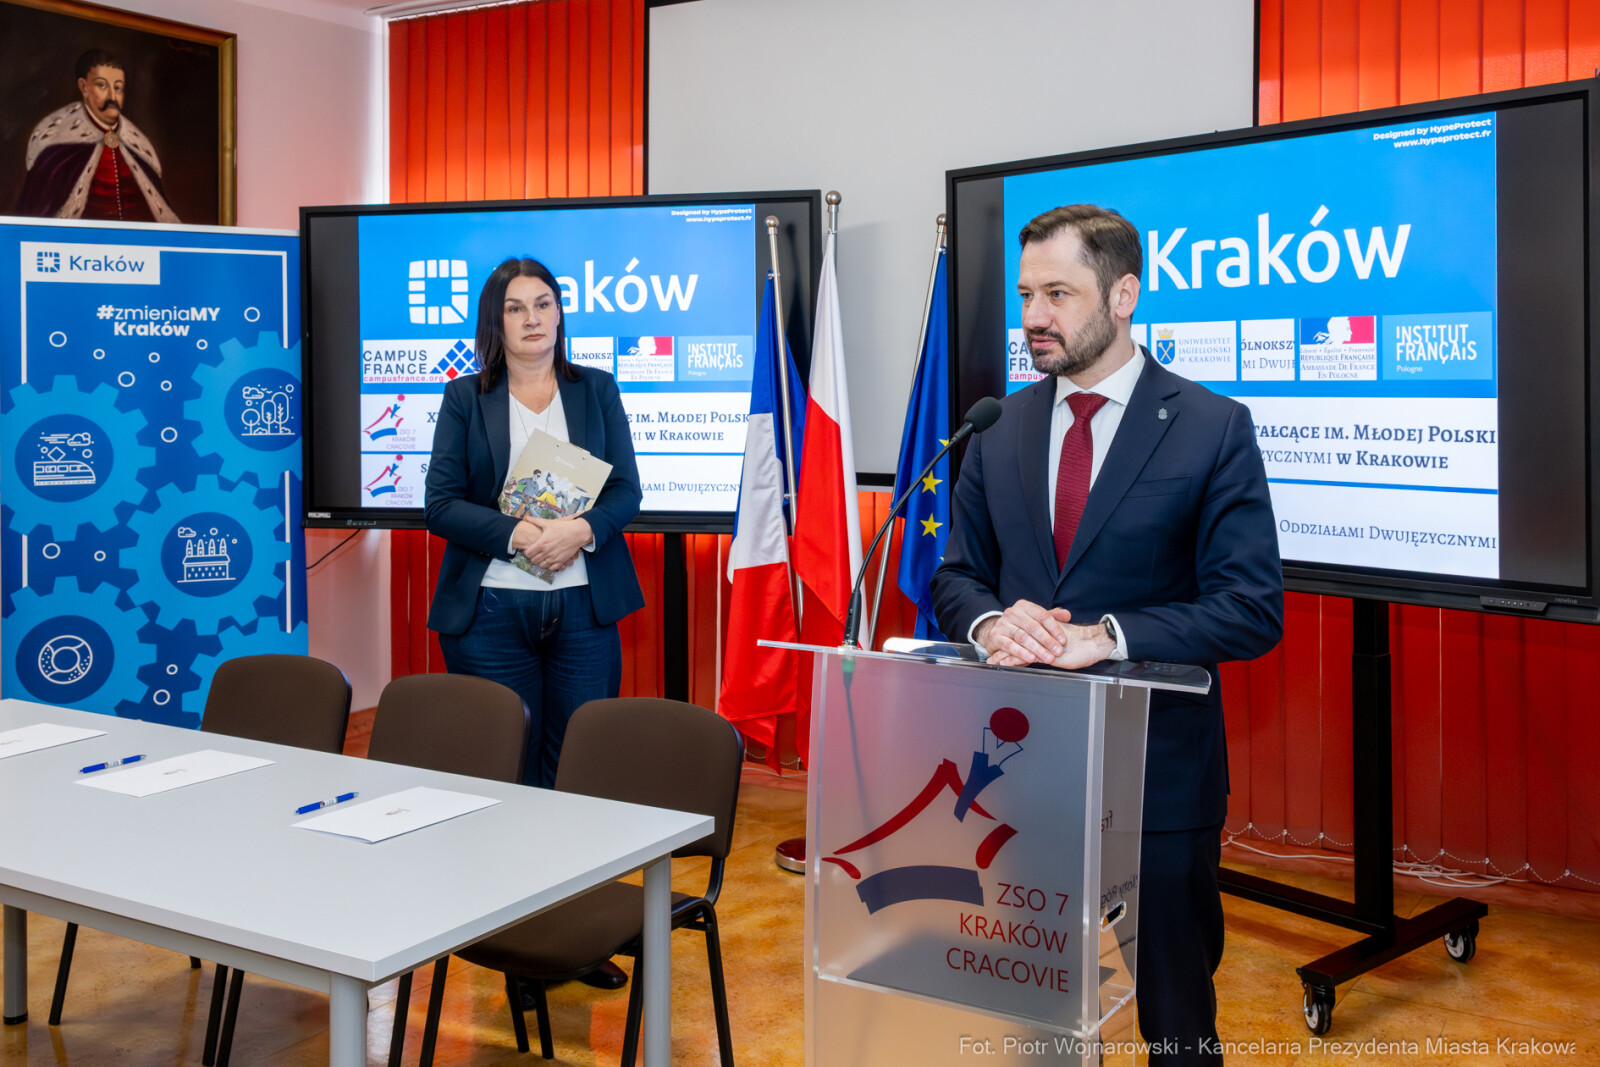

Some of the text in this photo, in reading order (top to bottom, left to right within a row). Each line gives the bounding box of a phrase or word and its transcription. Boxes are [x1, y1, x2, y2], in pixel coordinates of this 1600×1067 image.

[1373, 119, 1492, 140] Designed by HypeProtect
[1394, 130, 1492, 148] www.hypeprotect.fr
[1147, 204, 1411, 291] Kraków
[70, 255, 145, 272] Kraków
[97, 305, 220, 321] #zmieniaMY
[114, 321, 190, 336] Kraków
[1179, 337, 1231, 345] UNIWERSYTET
[1241, 338, 1295, 350] ÓLNOKSZ
[363, 350, 427, 361] CAMPUS
[571, 350, 613, 360] ÓLNOKSZ
[363, 364, 427, 374] FRANCE
[1396, 365, 1423, 374] Pologne
[363, 375, 444, 383] campusfrance.org
[659, 430, 724, 441] KRAKOWIE
[1324, 426, 1349, 440] IM.
[1428, 425, 1496, 444] POLSKI
[1356, 450, 1449, 469] KRAKOWIE
[1279, 519, 1497, 549] ODDZIAŁAMI DWUJĘZYCZNYMI
[996, 882, 1069, 915] ZSO 7
[960, 912, 1068, 954] KRAKÓW
[946, 947, 1069, 993] CRACOVIE
